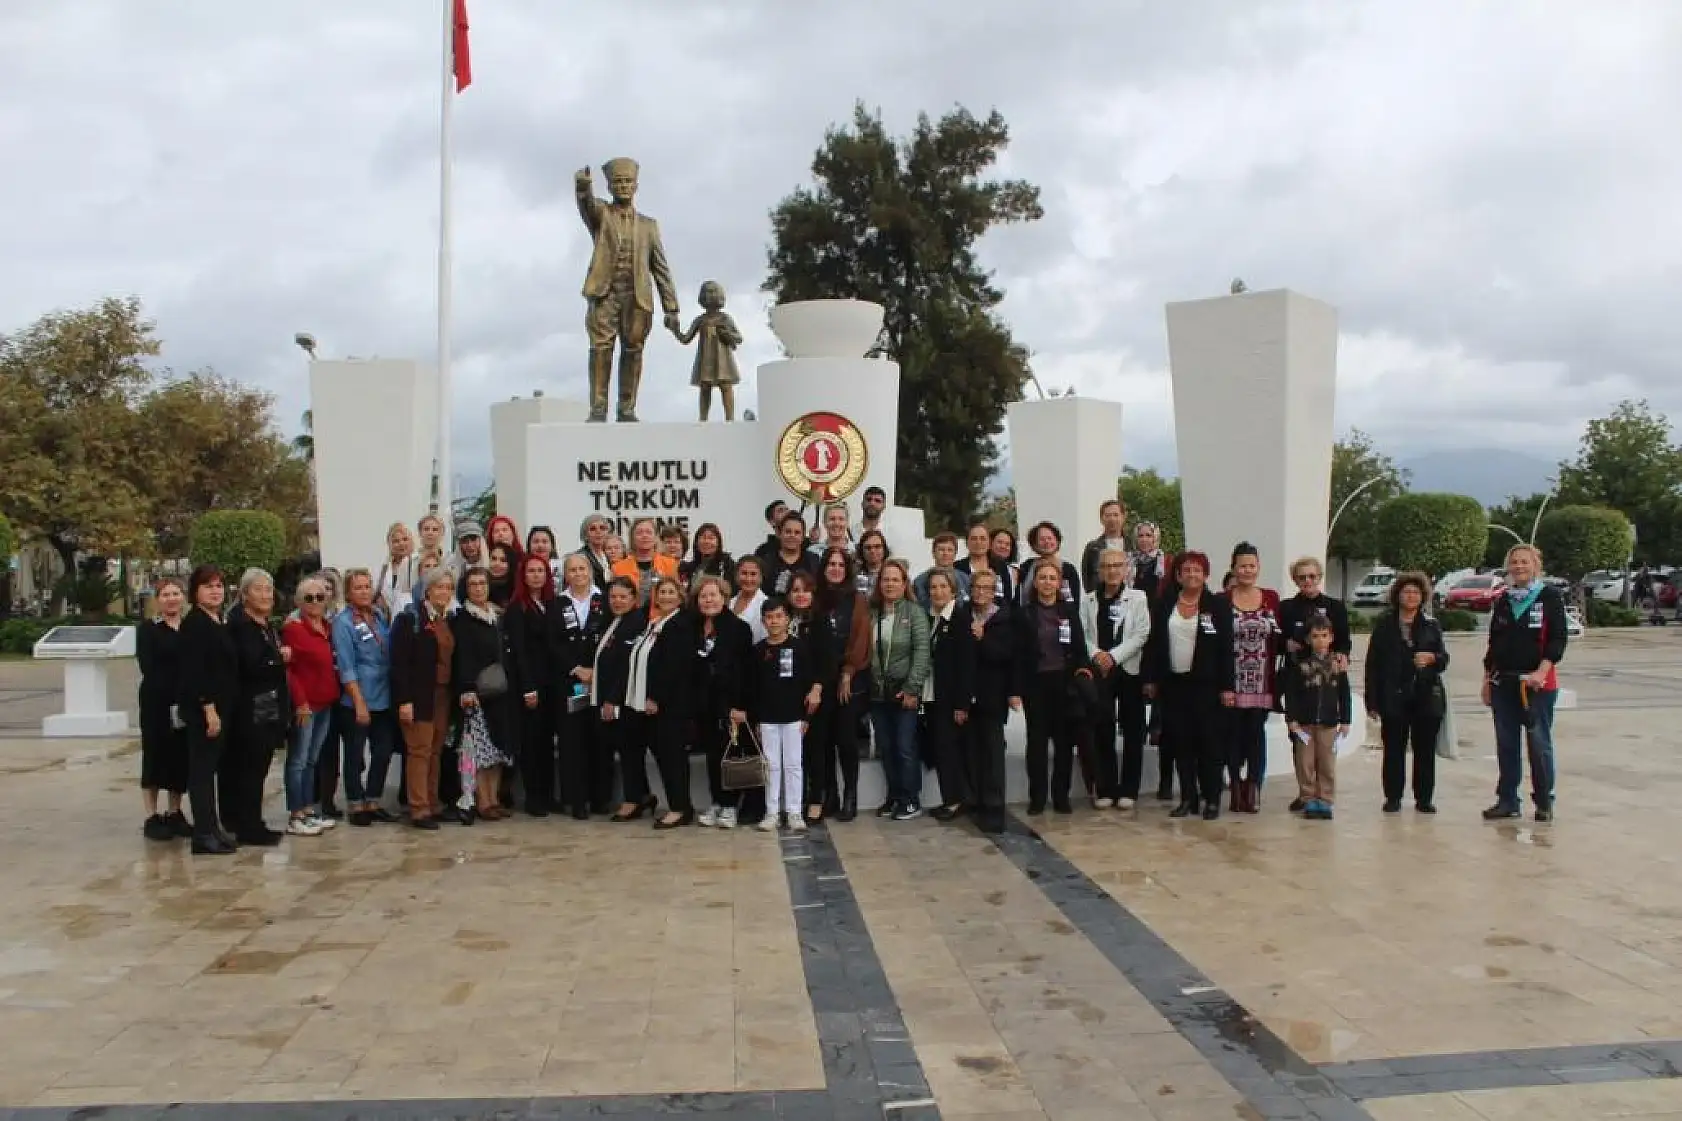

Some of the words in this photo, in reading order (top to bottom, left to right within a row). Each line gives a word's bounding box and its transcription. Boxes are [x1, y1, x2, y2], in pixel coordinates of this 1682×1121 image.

[577, 461, 610, 482] NE
[618, 460, 707, 482] MUTLU
[589, 483, 699, 510] TÜRKÜM
[602, 511, 689, 536] DİNE
